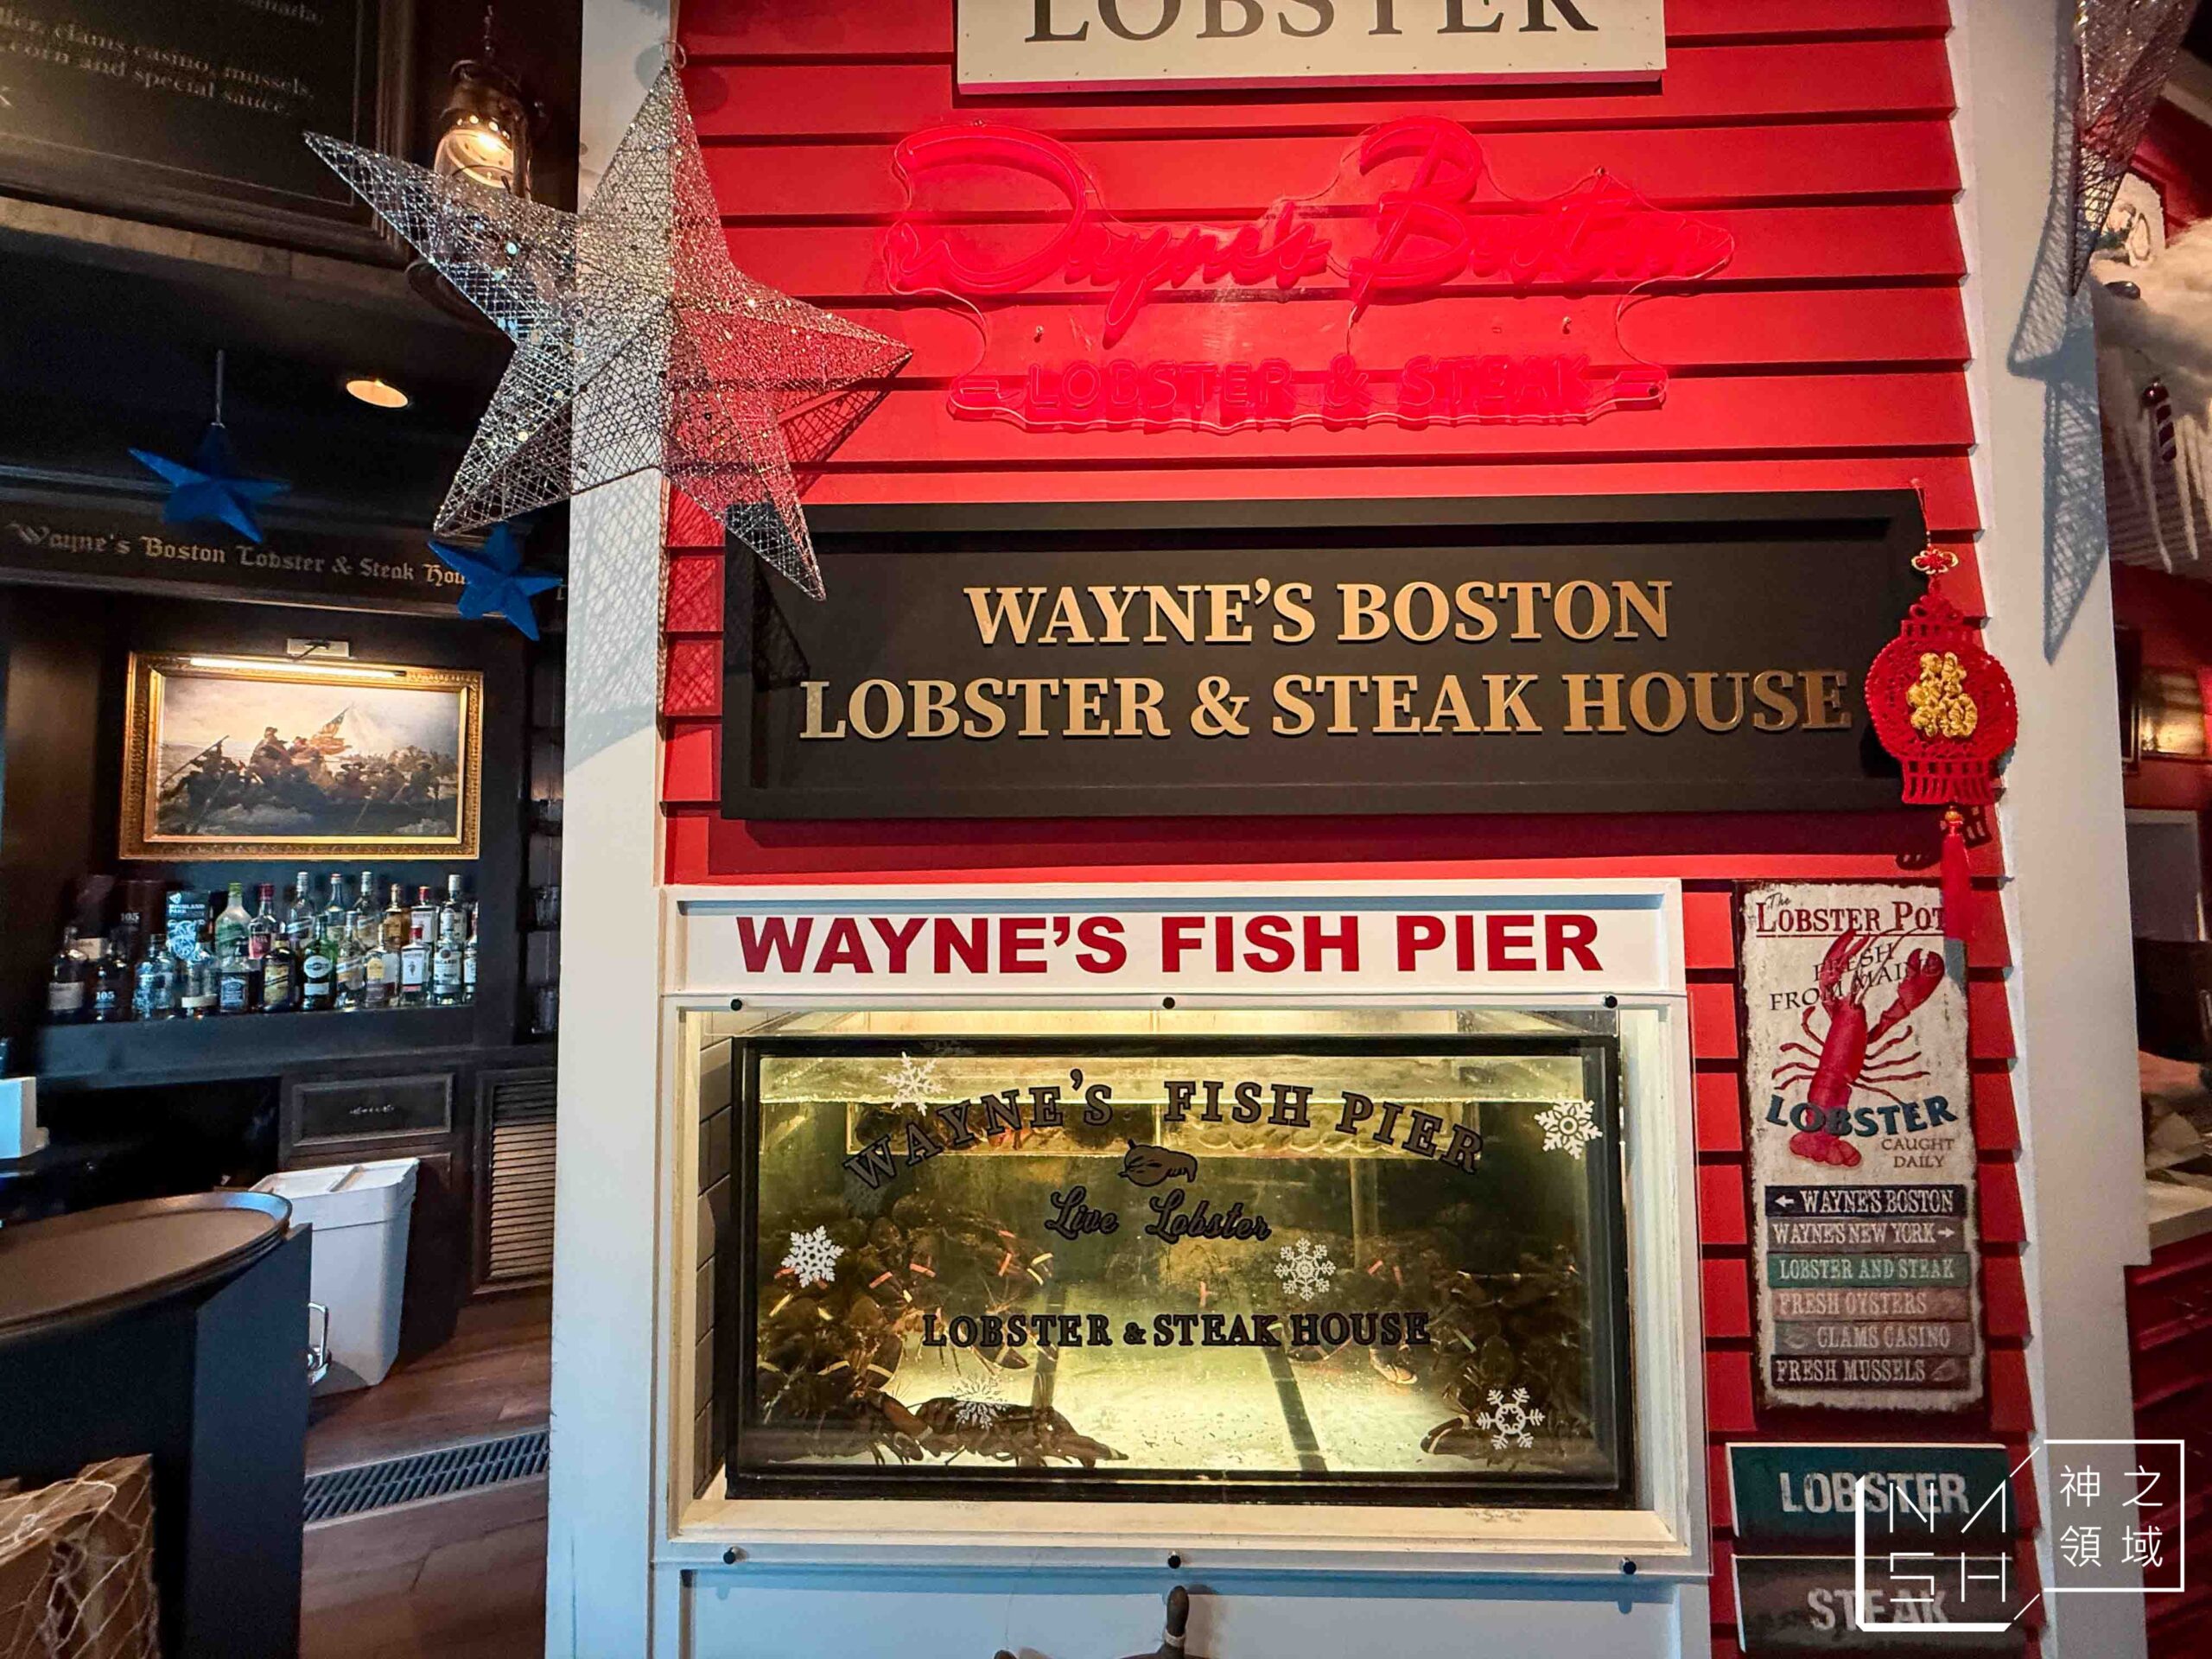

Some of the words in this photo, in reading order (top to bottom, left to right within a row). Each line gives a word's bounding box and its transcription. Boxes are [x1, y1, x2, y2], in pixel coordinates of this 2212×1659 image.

[131, 70, 215, 99] special
[1028, 356, 1296, 413] LOBSTER
[1324, 353, 1372, 410] &
[1402, 353, 1593, 408] STEAK
[5, 521, 130, 555] Wayne's
[140, 535, 226, 563] Boston
[236, 544, 326, 572] Lobster
[332, 556, 354, 575] &
[359, 557, 415, 582] Steak
[964, 577, 1317, 648] WAYNE'S
[1338, 579, 1673, 645] BOSTON
[799, 678, 1171, 741] LOBSTER
[1189, 676, 1253, 740] &
[1270, 672, 1541, 736] STEAK
[1562, 669, 1854, 734] HOUSE
[1766, 892, 1791, 908] The
[1756, 901, 1881, 932] LOBSTER
[737, 914, 1128, 975] WAYNE'S
[1160, 913, 1360, 973] FISH
[1396, 912, 1604, 971] PIER
[96, 991, 115, 1000] 105
[843, 1069, 1114, 1192] WAYNE'S
[1165, 1080, 1314, 1128] FISH
[1336, 1090, 1485, 1176] PIER
[1765, 1094, 1958, 1138] LOBSTER
[1881, 1138, 1955, 1152] CAUGHT
[1893, 1154, 1945, 1169] DAILY
[1045, 1185, 1119, 1241] Live
[1145, 1188, 1272, 1245] Lobster
[1800, 1189, 1883, 1213] WAYNE'S
[1885, 1190, 1954, 1212] BOSTON
[1772, 1223, 1846, 1244] WAYNE'S
[1849, 1223, 1889, 1244] NEW
[1890, 1223, 1936, 1243] YORK
[1779, 1259, 1853, 1280] LOBSTER
[1859, 1259, 1893, 1279] AND
[1899, 1259, 1955, 1279] STEAK
[1778, 1293, 1840, 1315] FRESH
[1845, 1293, 1927, 1314] OYSTERS
[922, 1314, 1114, 1347] LOBSTER
[1123, 1322, 1147, 1345] &
[1153, 1313, 1282, 1346] STEAK
[1291, 1311, 1433, 1345] HOUSE
[1816, 1326, 1879, 1348] CLAMS
[1884, 1326, 1951, 1348] CASINO
[1776, 1359, 1838, 1382] FRESH
[1843, 1359, 1926, 1382] MUSSELS
[1779, 1471, 1970, 1514] LOBSTER
[1808, 1588, 1949, 1631] STEAK
